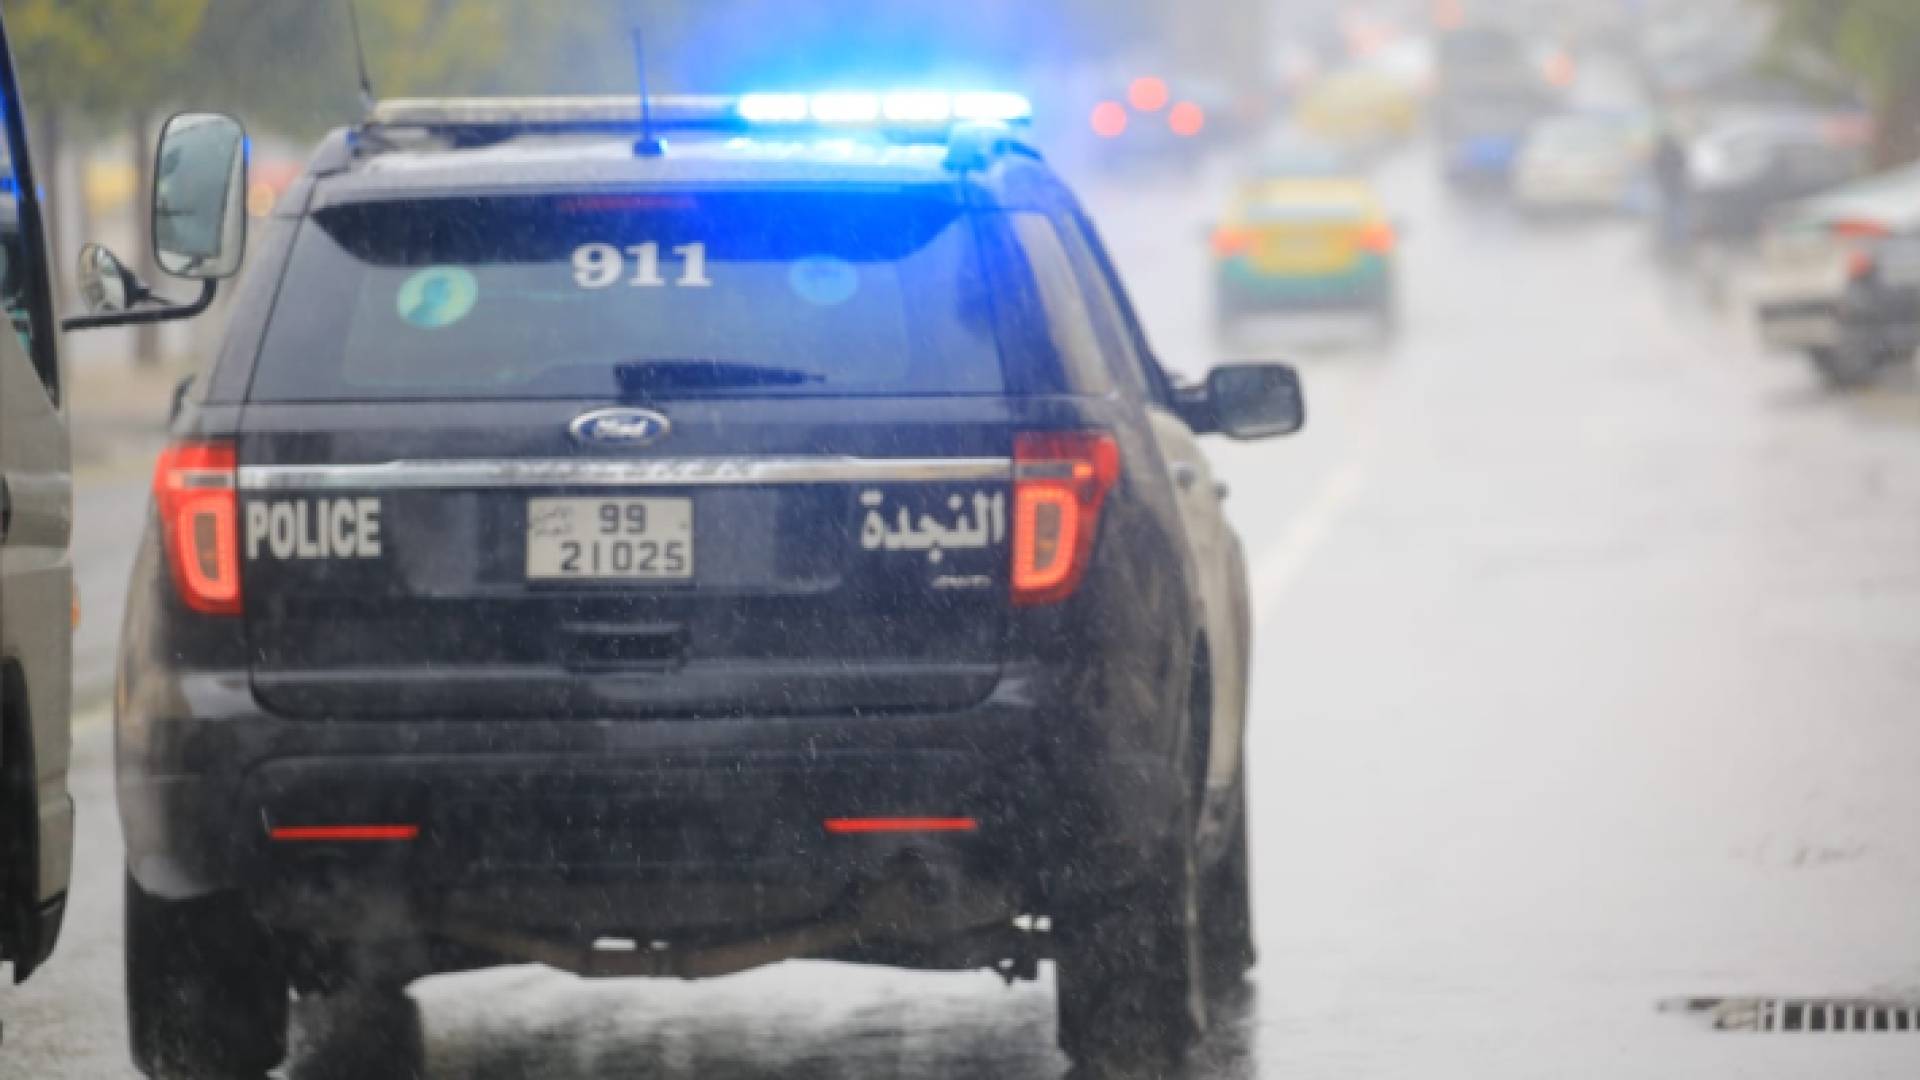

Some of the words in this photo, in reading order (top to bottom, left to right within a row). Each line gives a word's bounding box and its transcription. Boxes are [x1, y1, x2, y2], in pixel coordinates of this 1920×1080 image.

[571, 243, 713, 288] 911
[247, 497, 382, 559] POLICE
[600, 503, 646, 534] 99
[860, 489, 1005, 564] النجدة
[561, 541, 684, 572] 21025
